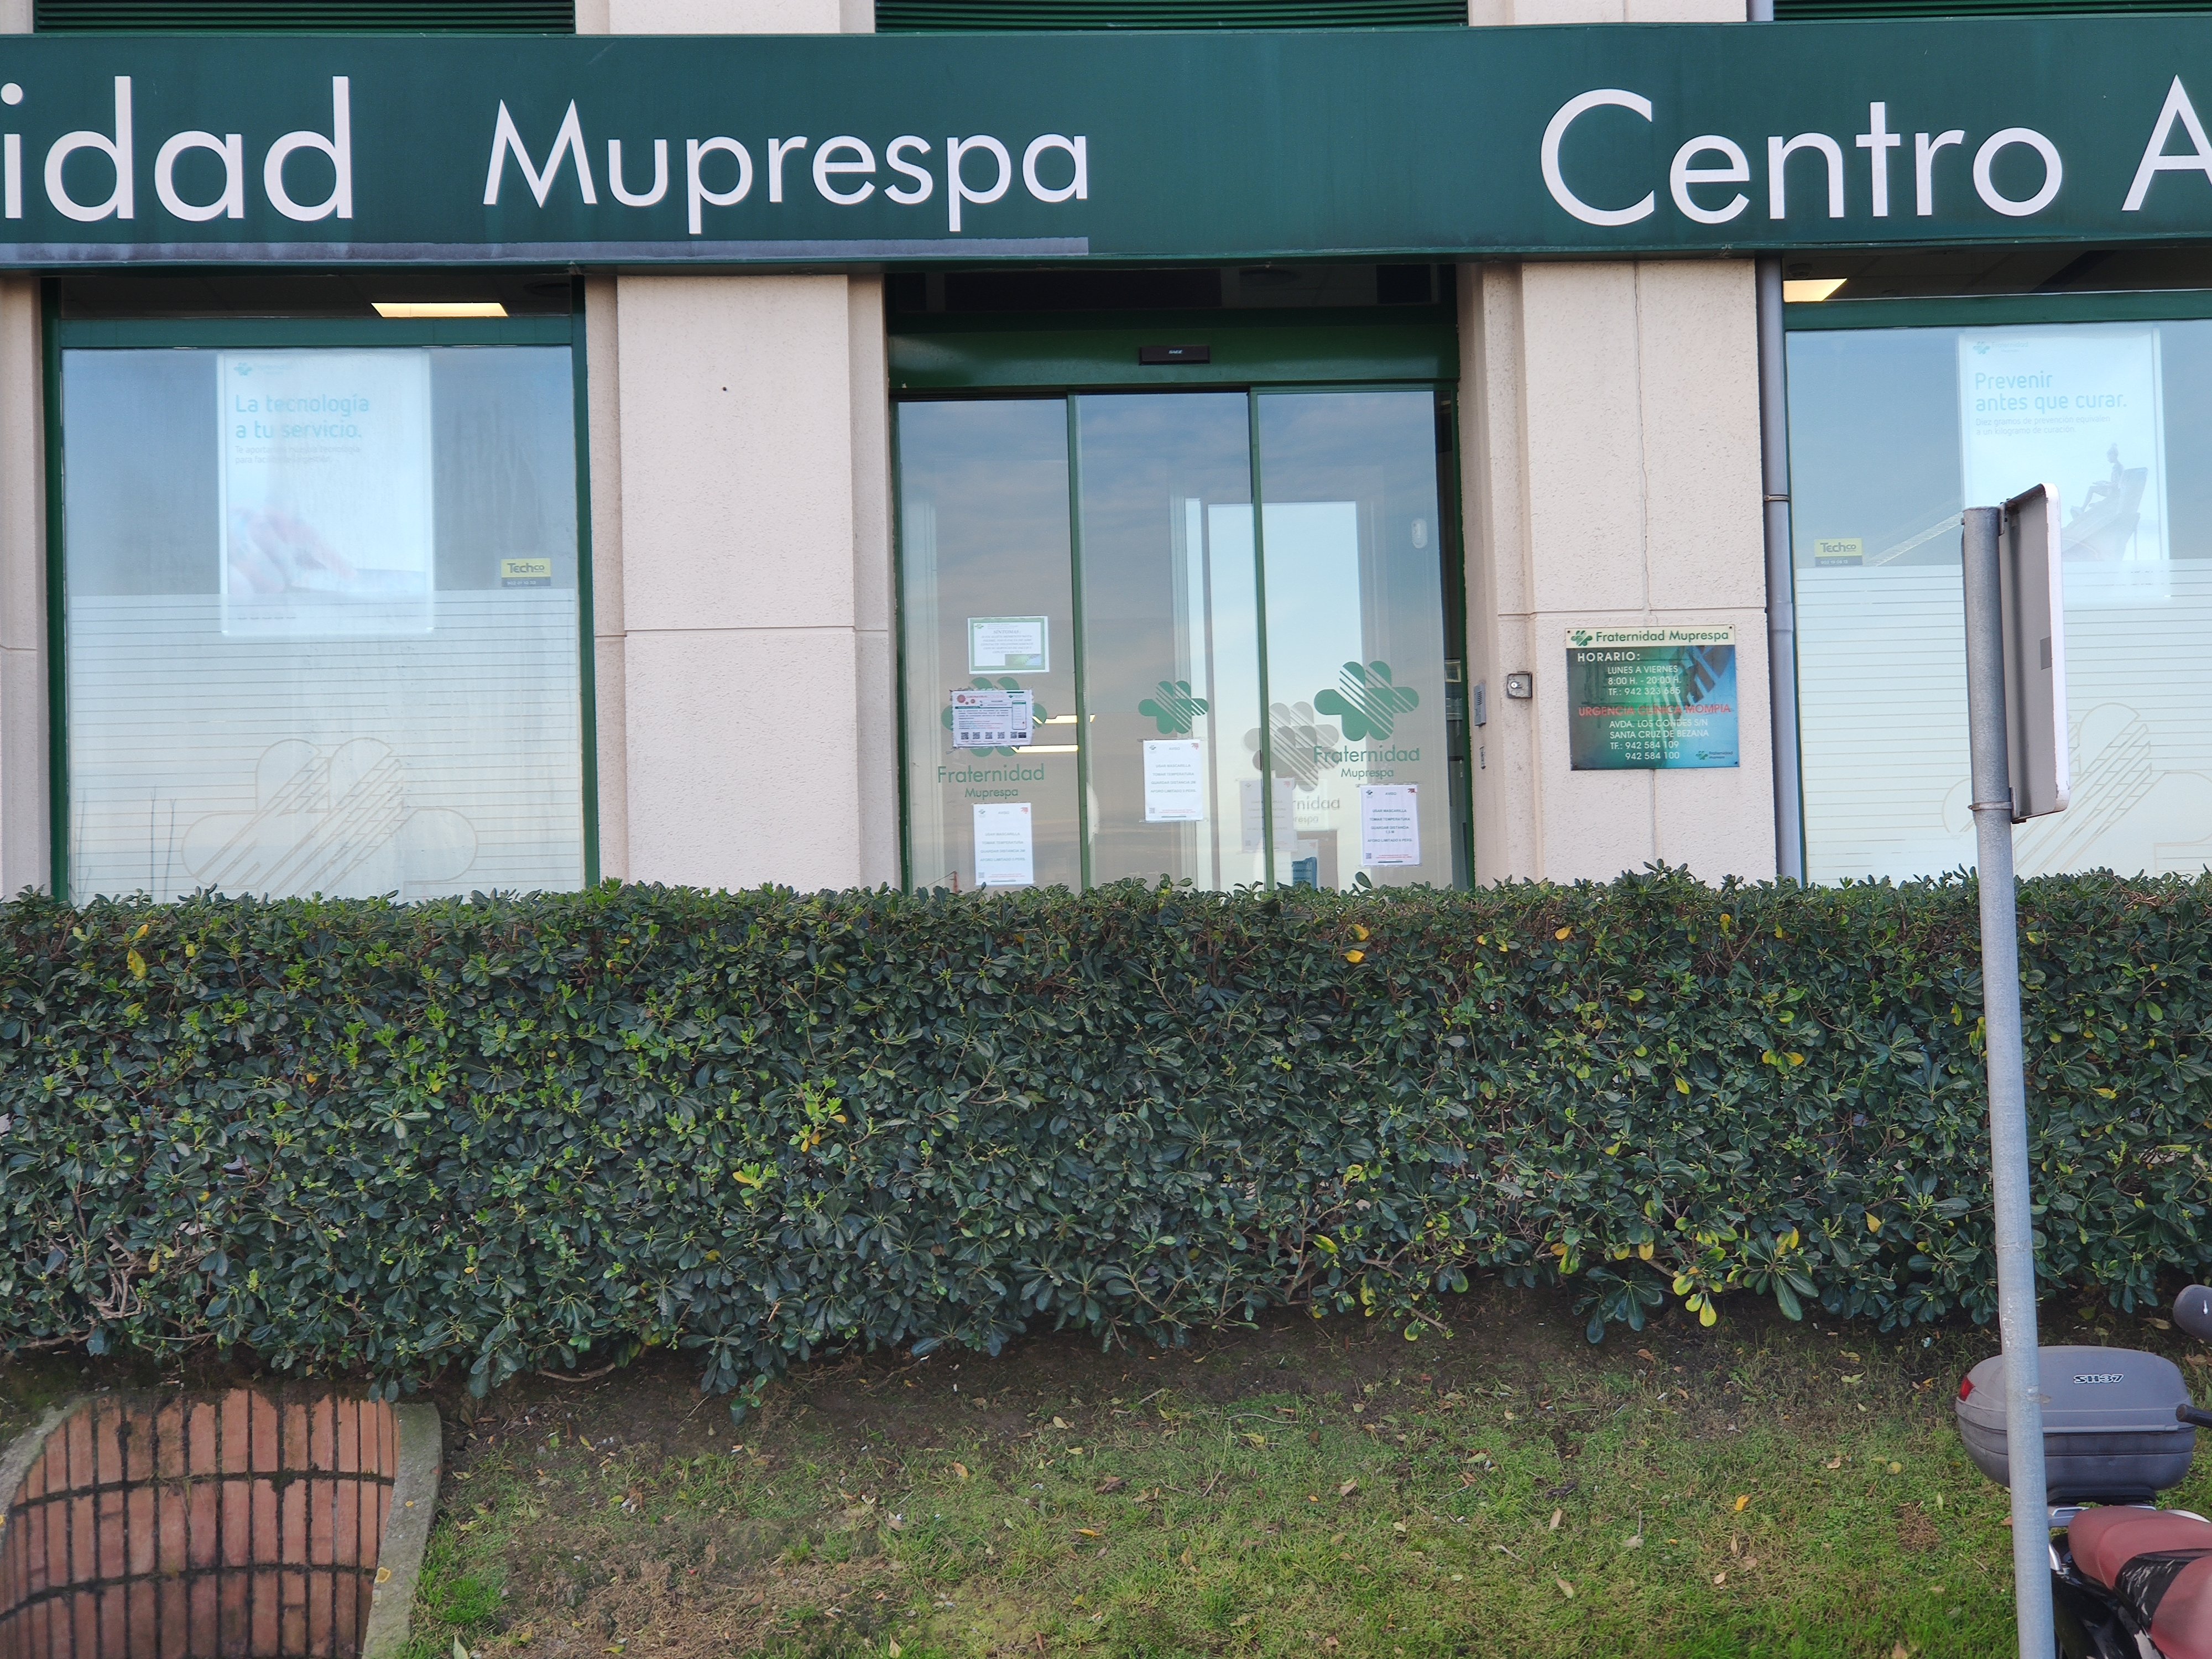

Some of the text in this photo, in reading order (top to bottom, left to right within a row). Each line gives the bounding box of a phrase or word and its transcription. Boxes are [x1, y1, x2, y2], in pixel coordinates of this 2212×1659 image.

[1, 76, 1088, 234] idad Muprespa
[1541, 75, 2212, 226] Centro A
[1975, 370, 2053, 389] Prevenir
[236, 393, 370, 418] La tecnología
[1975, 393, 2127, 414] antes que curar.
[1994, 419, 2022, 427] gramos
[2034, 415, 2074, 426] prevención
[2075, 415, 2111, 425] equivalen
[236, 420, 362, 439] a tu servicio.
[1994, 426, 2031, 436] kilogramo
[1819, 541, 1856, 552] Techco
[507, 562, 545, 573] Techco
[1596, 630, 1729, 643] Fraternidad Muprespa
[1577, 651, 1640, 662] HORARIO:
[1608, 666, 1633, 674] LUNES
[1663, 686, 1681, 695] 685
[1578, 702, 1731, 717] URGENCIA CLÍNICA MOMPIA
[1655, 719, 1692, 727] CONDES
[1677, 729, 1709, 738] BEZANA
[1313, 745, 1420, 763] Fraternidad
[938, 763, 1044, 783] Fraternidad
[1341, 768, 1394, 780] Muprespa
[964, 788, 1019, 800] Muprespa
[2074, 1374, 2124, 1384] SH37
